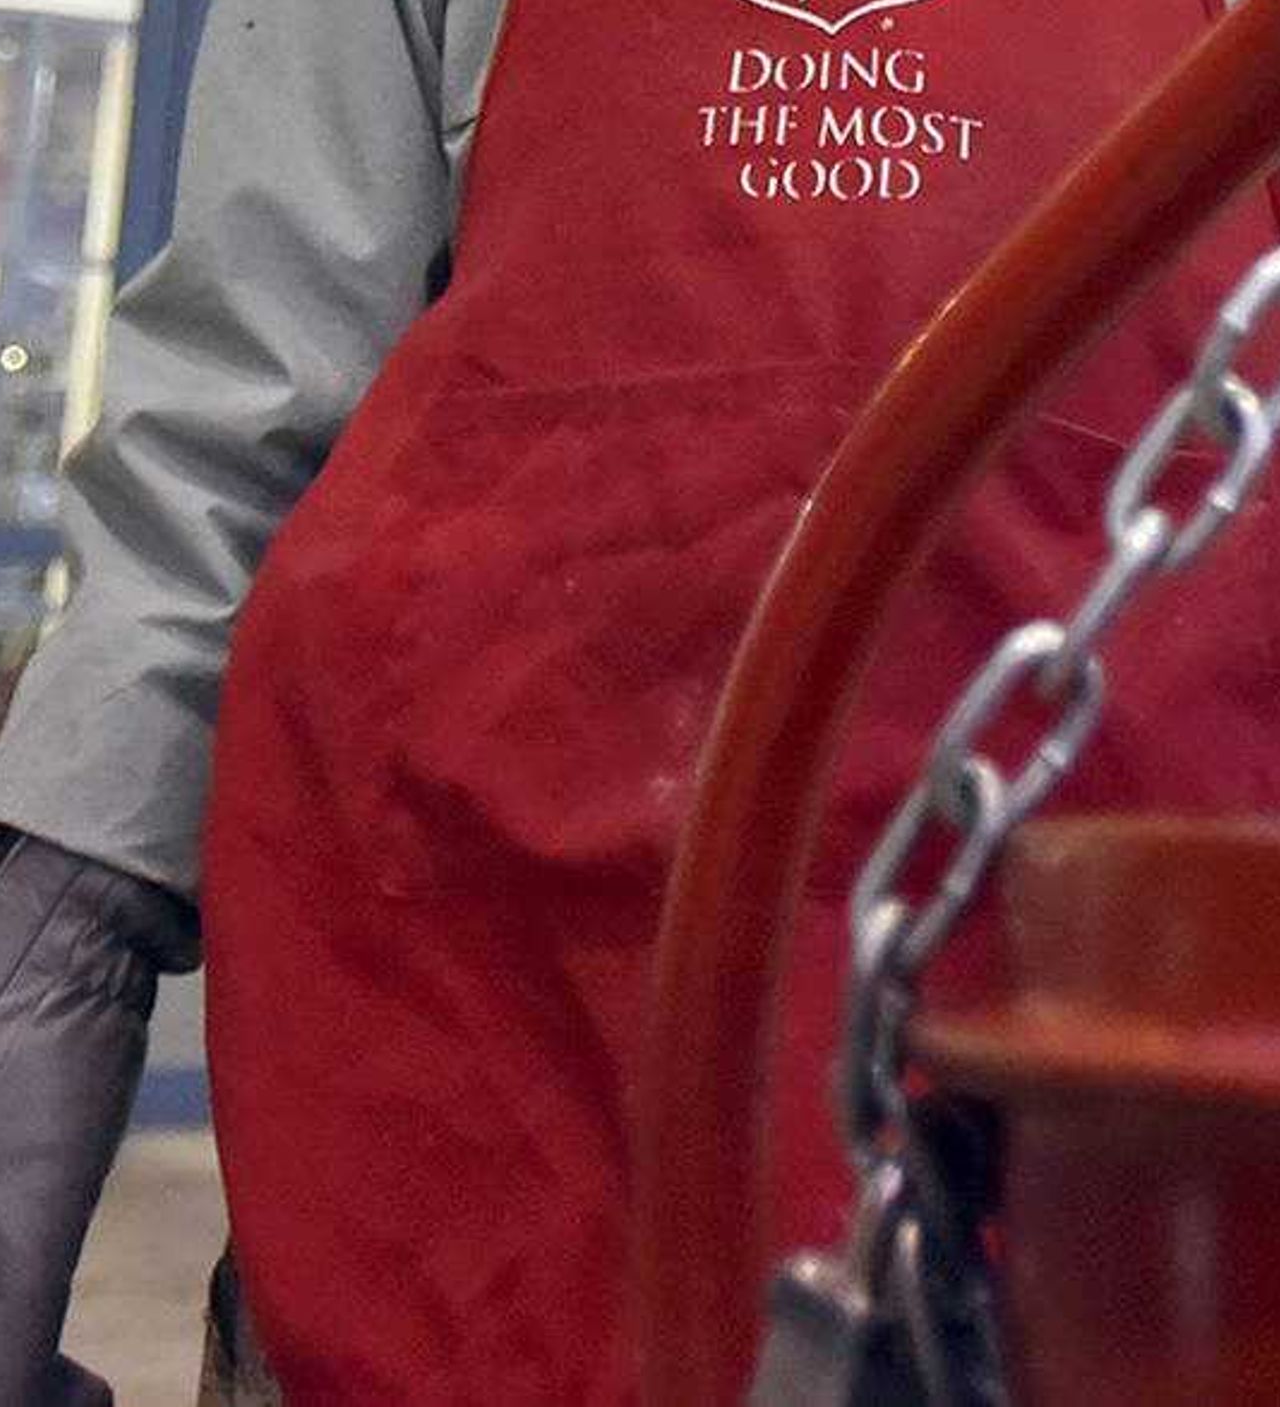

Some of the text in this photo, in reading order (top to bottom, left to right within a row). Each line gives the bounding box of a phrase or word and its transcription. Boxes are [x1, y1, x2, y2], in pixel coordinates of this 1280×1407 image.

[729, 48, 925, 93] DOING
[698, 105, 983, 160] THE MOST
[740, 157, 921, 201] GOOD
